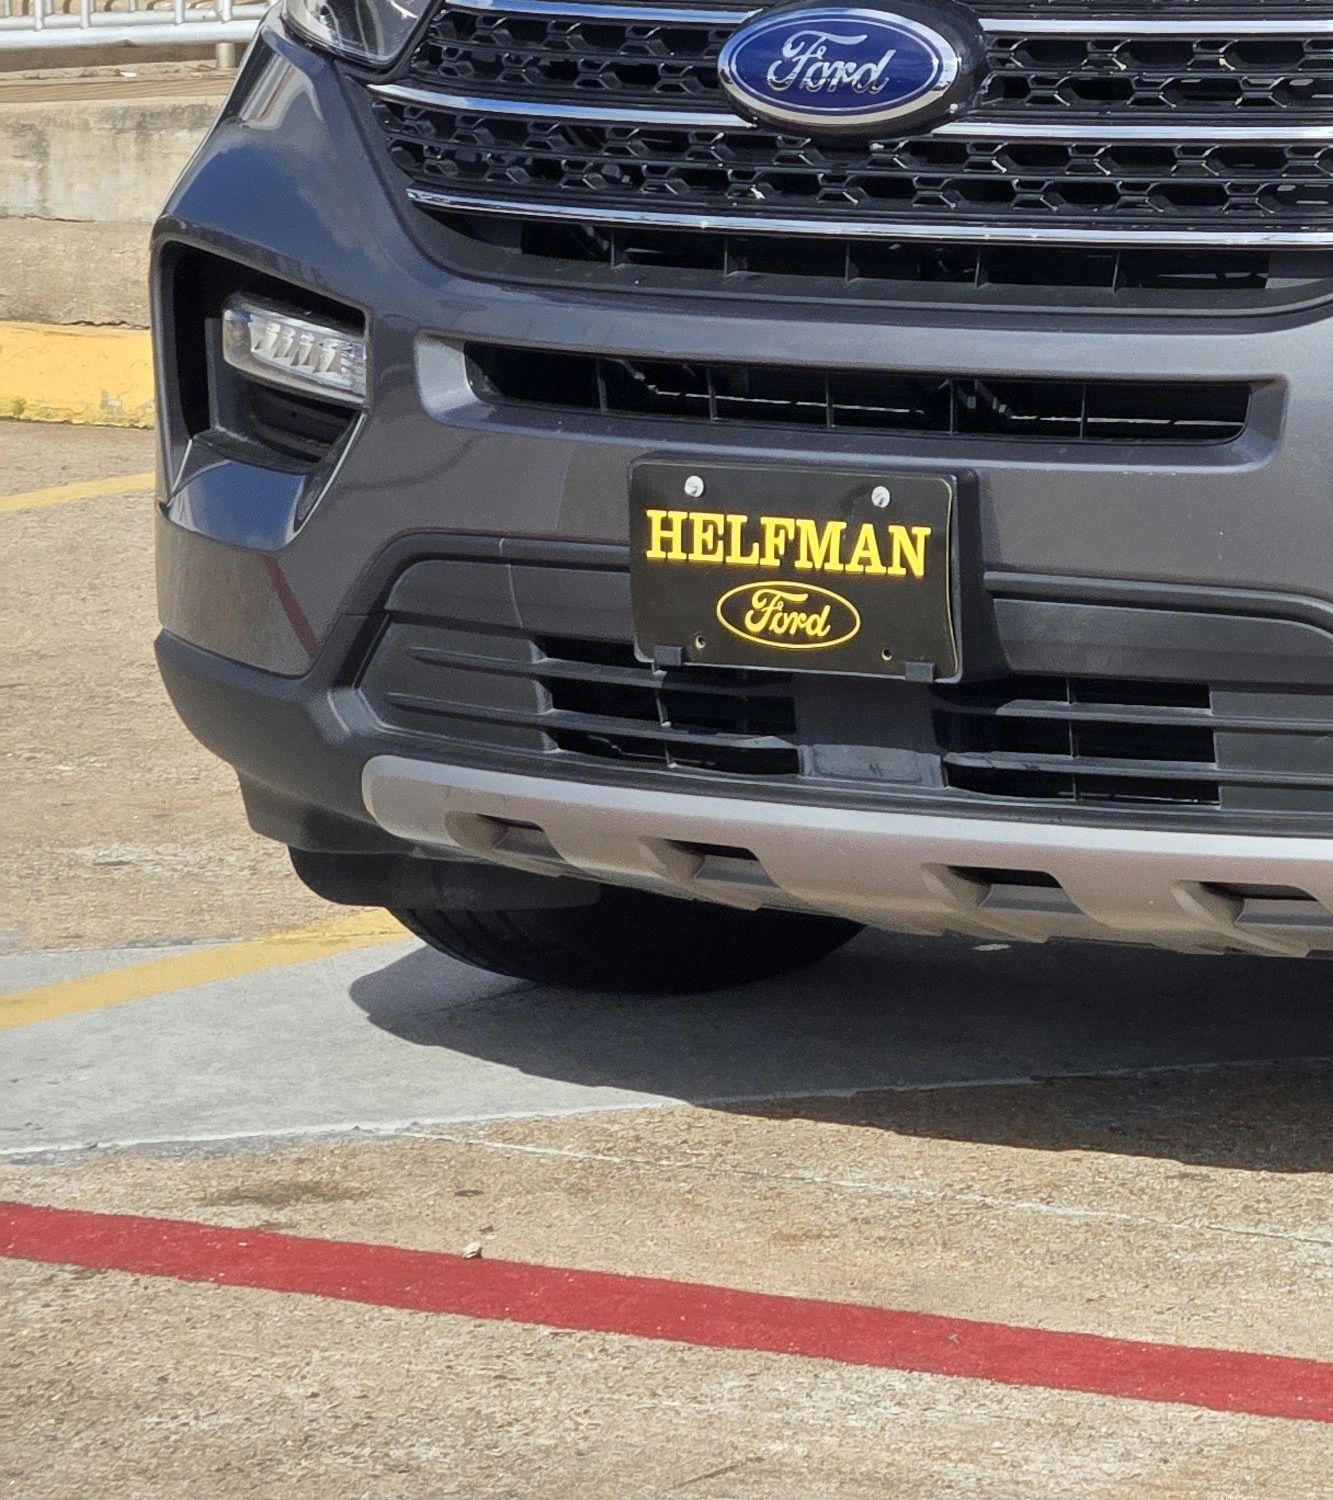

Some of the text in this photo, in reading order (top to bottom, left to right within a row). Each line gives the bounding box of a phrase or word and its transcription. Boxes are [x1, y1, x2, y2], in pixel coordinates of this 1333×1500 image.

[766, 27, 892, 97] Ford
[645, 507, 932, 579] HELFMAN
[744, 588, 830, 639] Ford
